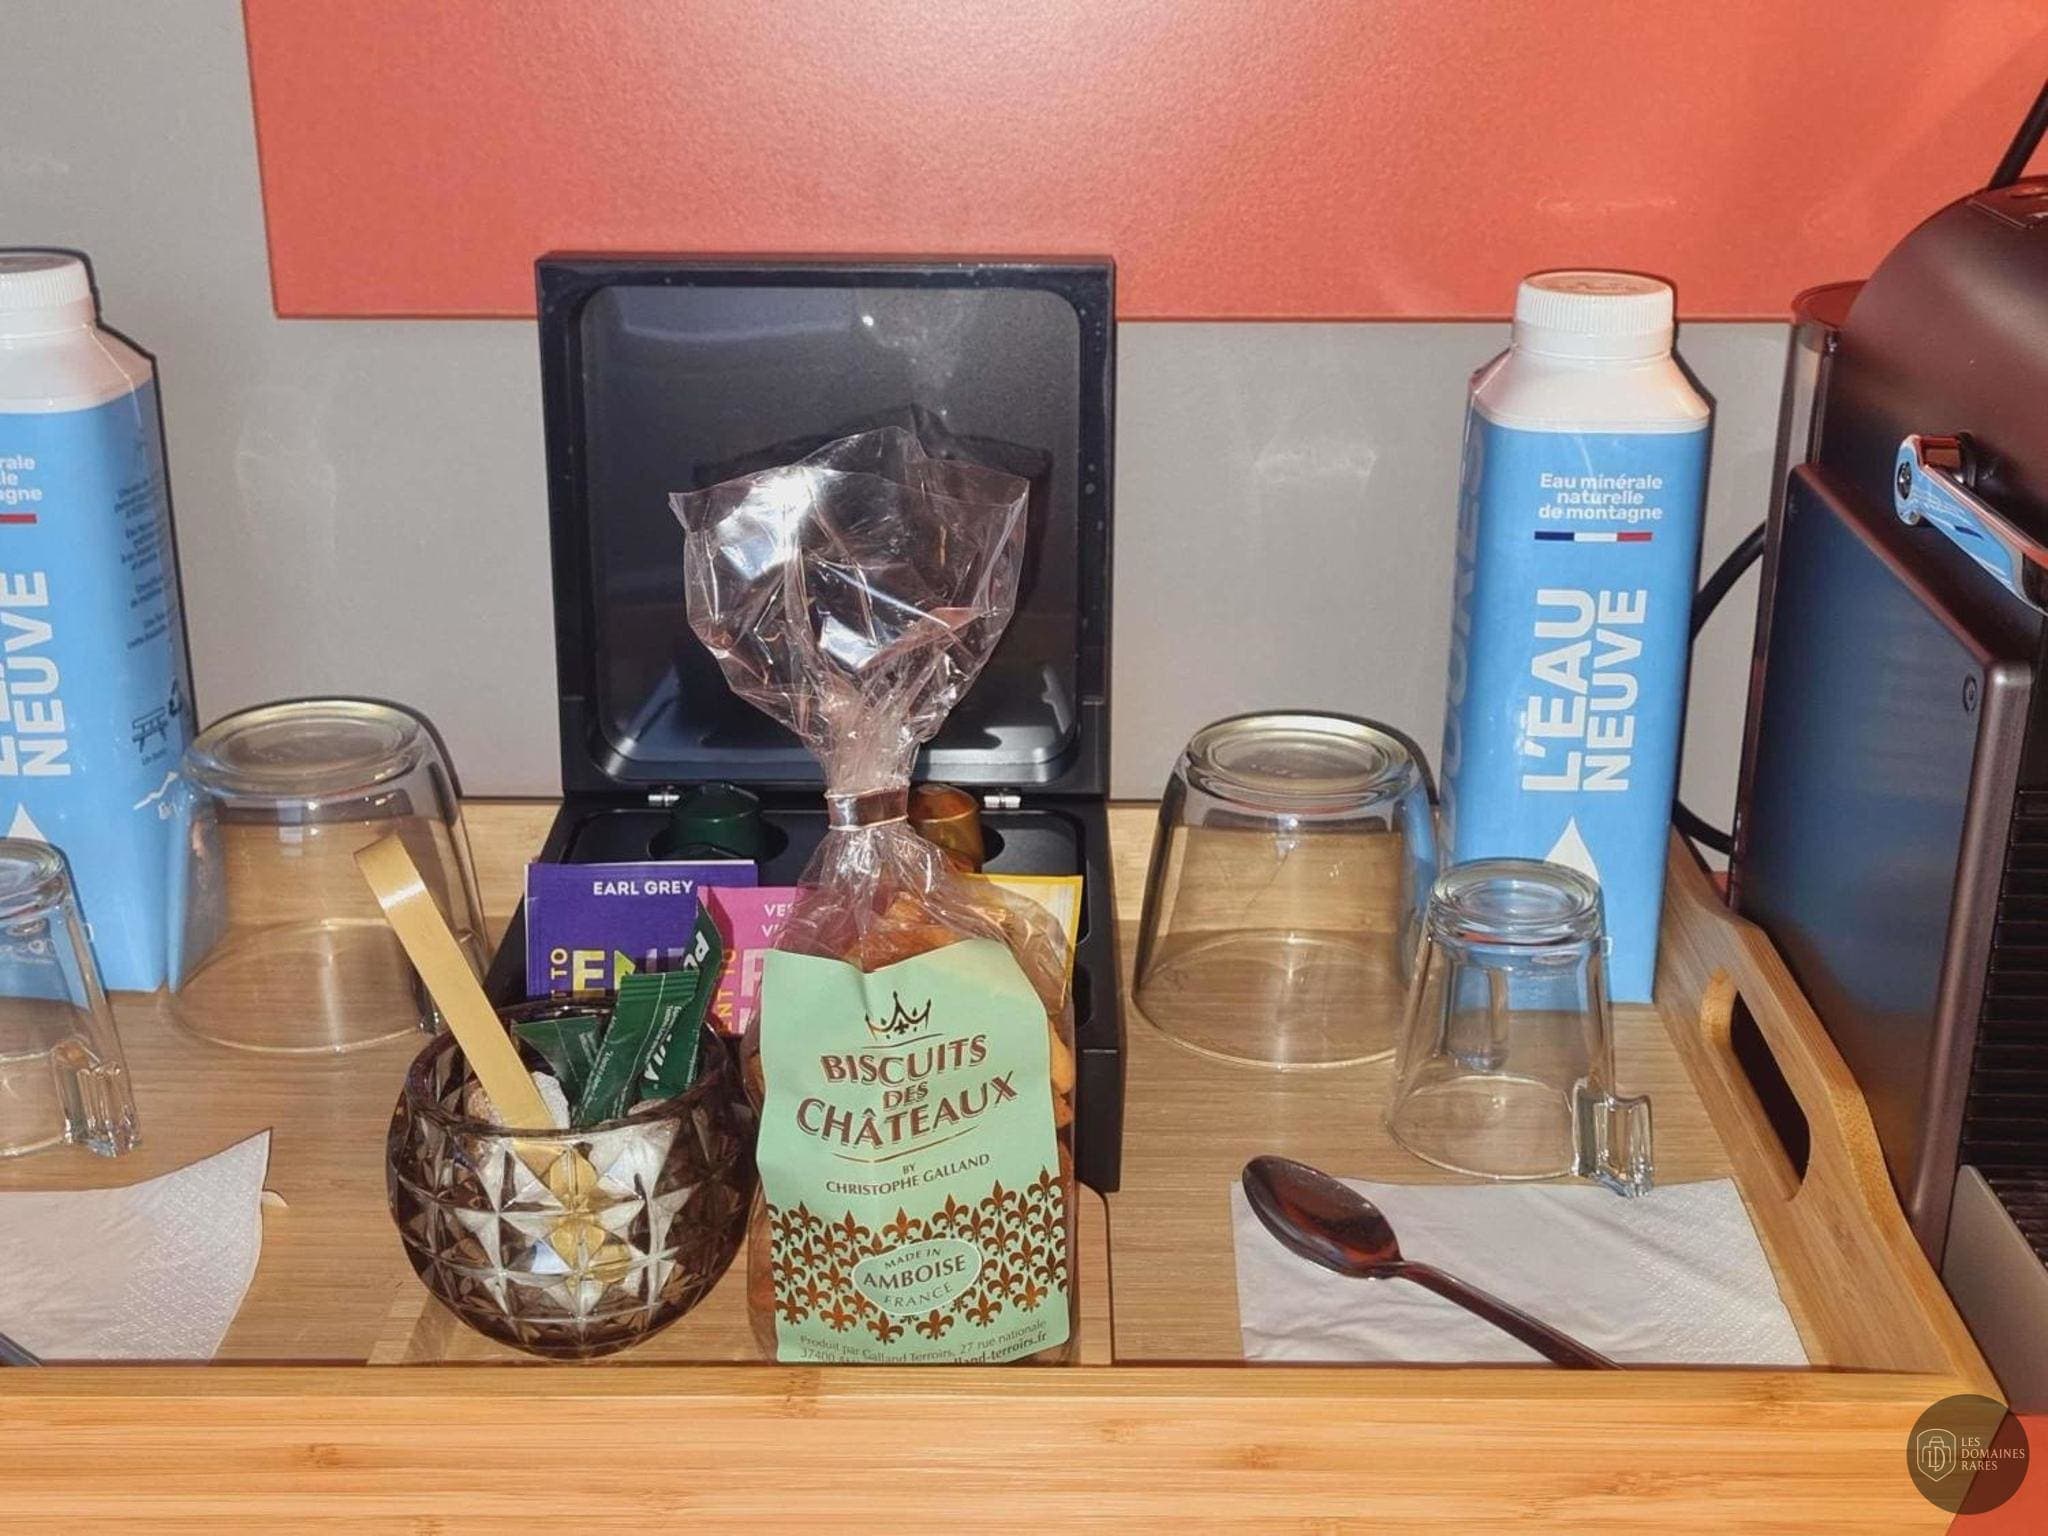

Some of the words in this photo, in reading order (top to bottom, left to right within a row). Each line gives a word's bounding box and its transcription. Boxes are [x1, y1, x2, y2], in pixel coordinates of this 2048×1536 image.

[1540, 472, 1576, 489] Eau
[1580, 472, 1663, 489] minérale
[1557, 489, 1644, 505] naturelle
[1538, 503, 1563, 519] de
[1566, 506, 1663, 524] montagne
[0, 571, 72, 777] NEUVE
[1521, 588, 1596, 793] L'EAU
[1583, 589, 1648, 792] NEUVE
[593, 881, 640, 896] EARL
[644, 880, 694, 895] GREY
[550, 947, 568, 981] TO
[820, 1034, 987, 1087] BISCUITS
[796, 1070, 1019, 1149] CHÂTEAUX
[883, 1081, 929, 1110] DES
[826, 1175, 919, 1196] CHRISTOPHE
[923, 1153, 990, 1183] GALLAND
[902, 1162, 917, 1175] BY
[863, 1254, 966, 1290] AMBOISE
[884, 1250, 921, 1268] MADE
[926, 1248, 942, 1256] IN
[884, 1282, 954, 1307] FRANCE
[800, 1335, 839, 1351] Produit
[842, 1344, 859, 1355] par
[960, 1341, 973, 1355] 27
[978, 1337, 996, 1350] rue
[999, 1320, 1047, 1345] nationale
